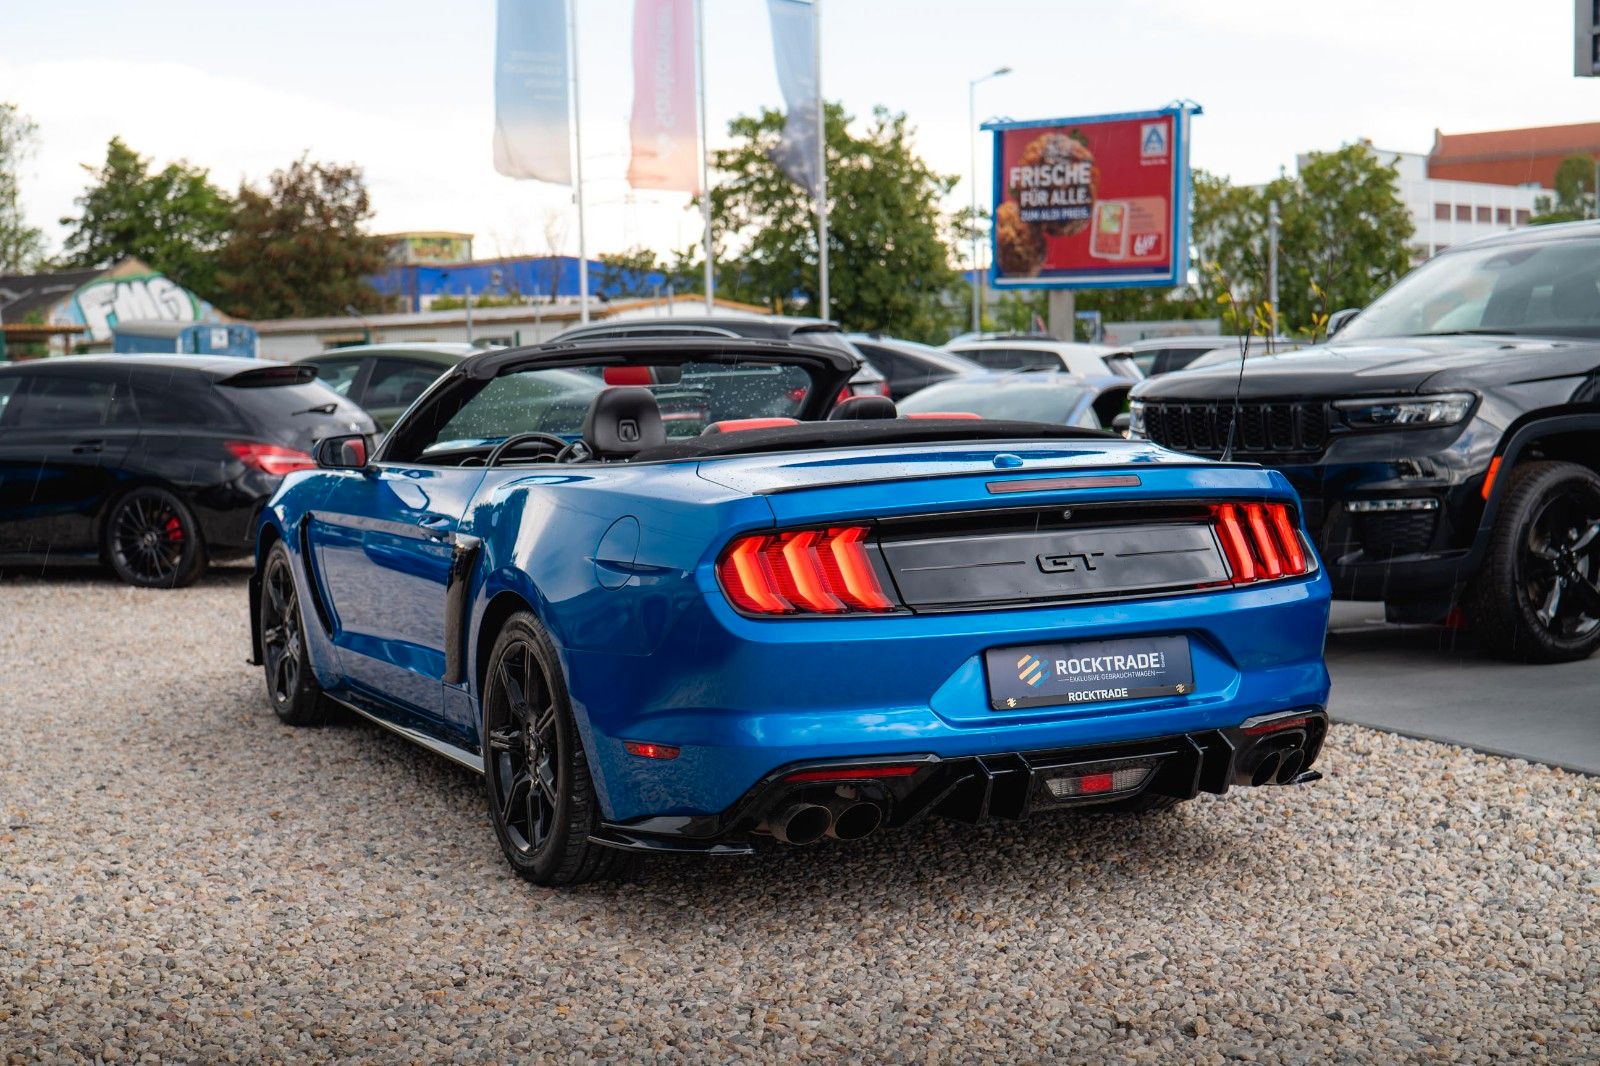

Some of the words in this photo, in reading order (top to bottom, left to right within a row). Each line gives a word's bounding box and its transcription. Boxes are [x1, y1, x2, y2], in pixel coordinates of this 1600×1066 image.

[1009, 162, 1091, 189] FRISCHE
[1020, 187, 1049, 208] FÜR
[1036, 551, 1104, 574] GT
[1056, 652, 1160, 675] ROCKTRADE
[1069, 674, 1101, 682] EXKLUSIVE
[1101, 670, 1156, 680] GEBRAUCHTWAGEN
[1068, 687, 1128, 702] ROCKTRADE
